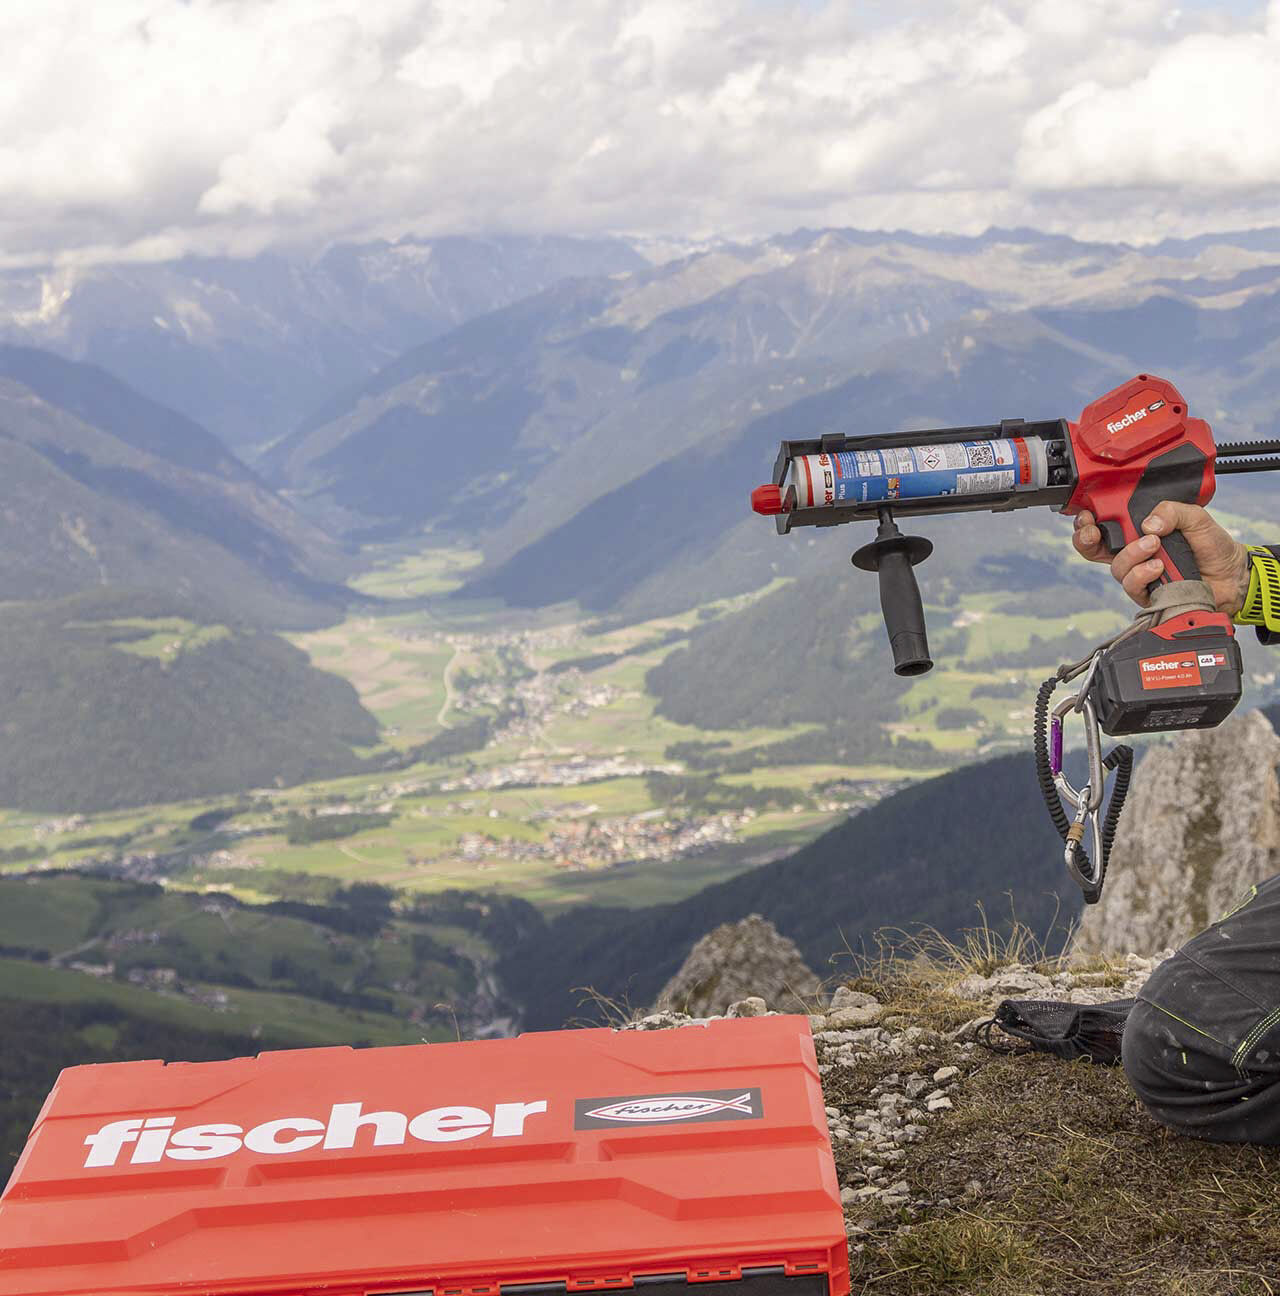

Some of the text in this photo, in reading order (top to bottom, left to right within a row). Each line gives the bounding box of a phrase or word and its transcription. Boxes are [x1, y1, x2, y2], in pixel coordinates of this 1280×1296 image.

[1106, 408, 1147, 434] fischer
[1142, 661, 1179, 672] fischer
[614, 1103, 712, 1115] fischer
[83, 1100, 547, 1168] fischer
